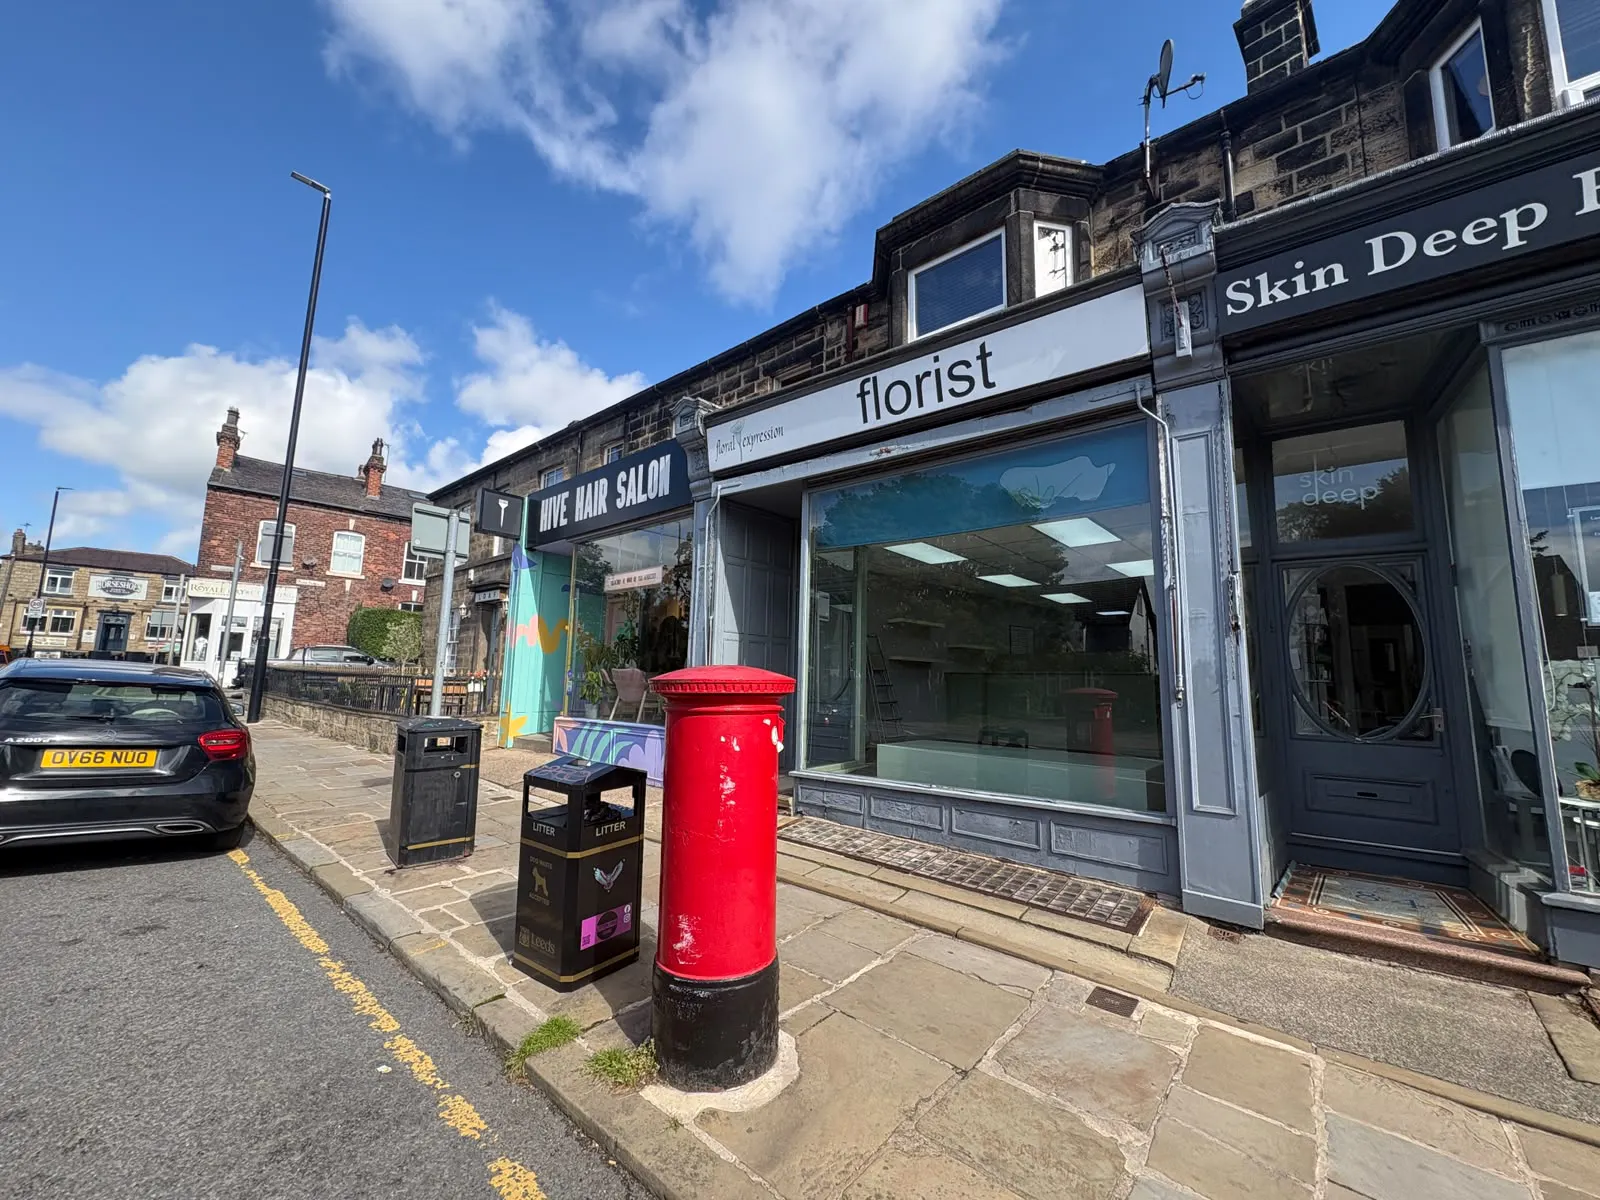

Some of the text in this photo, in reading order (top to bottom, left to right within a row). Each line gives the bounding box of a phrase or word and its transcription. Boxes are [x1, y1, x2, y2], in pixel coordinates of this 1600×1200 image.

[1226, 202, 1548, 316] Skin Deep
[856, 341, 997, 424] florist
[715, 425, 784, 462] floral expression
[539, 453, 671, 533] HIVE HAIR SALON
[1302, 483, 1380, 511] deep
[51, 751, 148, 764] OV66 NUO
[532, 822, 556, 836] LITTER
[595, 820, 626, 837] LITTER
[531, 932, 556, 954] Leeds
